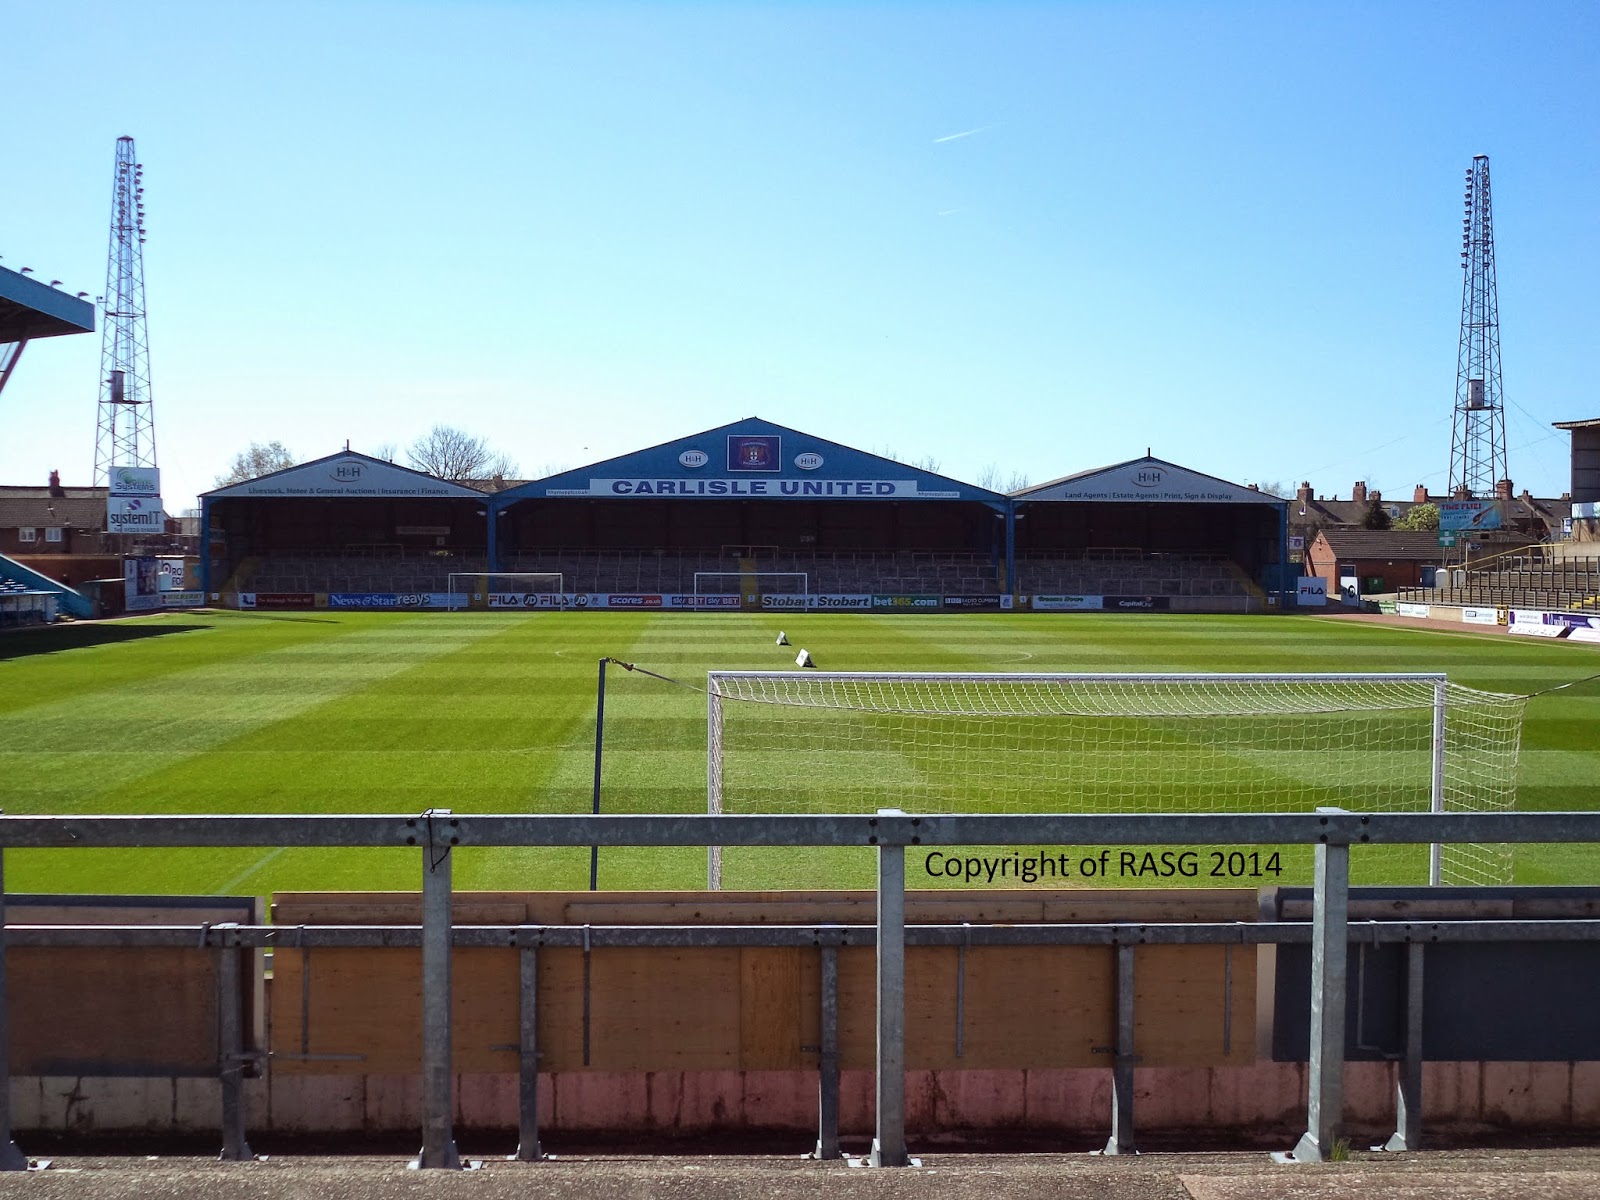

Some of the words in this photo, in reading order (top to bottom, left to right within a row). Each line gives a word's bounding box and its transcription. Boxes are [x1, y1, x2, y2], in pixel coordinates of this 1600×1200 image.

[115, 482, 155, 491] Systems
[345, 487, 376, 495] Auctions
[381, 487, 416, 495] Insurance
[421, 487, 449, 495] Finance
[611, 480, 768, 496] CARLISLE
[780, 481, 896, 496] UNITED
[1135, 492, 1159, 500] Agents
[1164, 492, 1183, 500] Print,
[1184, 492, 1199, 500] Sign
[1207, 492, 1233, 501] Display
[1300, 586, 1324, 595] FILA
[330, 594, 361, 606] News
[372, 594, 396, 606] Star
[397, 593, 431, 606] reays
[489, 595, 519, 605] FILA
[540, 595, 570, 605] FILA
[707, 597, 720, 606] sky
[722, 597, 739, 605] BET
[762, 596, 814, 607] Stobart
[818, 596, 869, 607] Stobart
[873, 596, 938, 607] bet365.com
